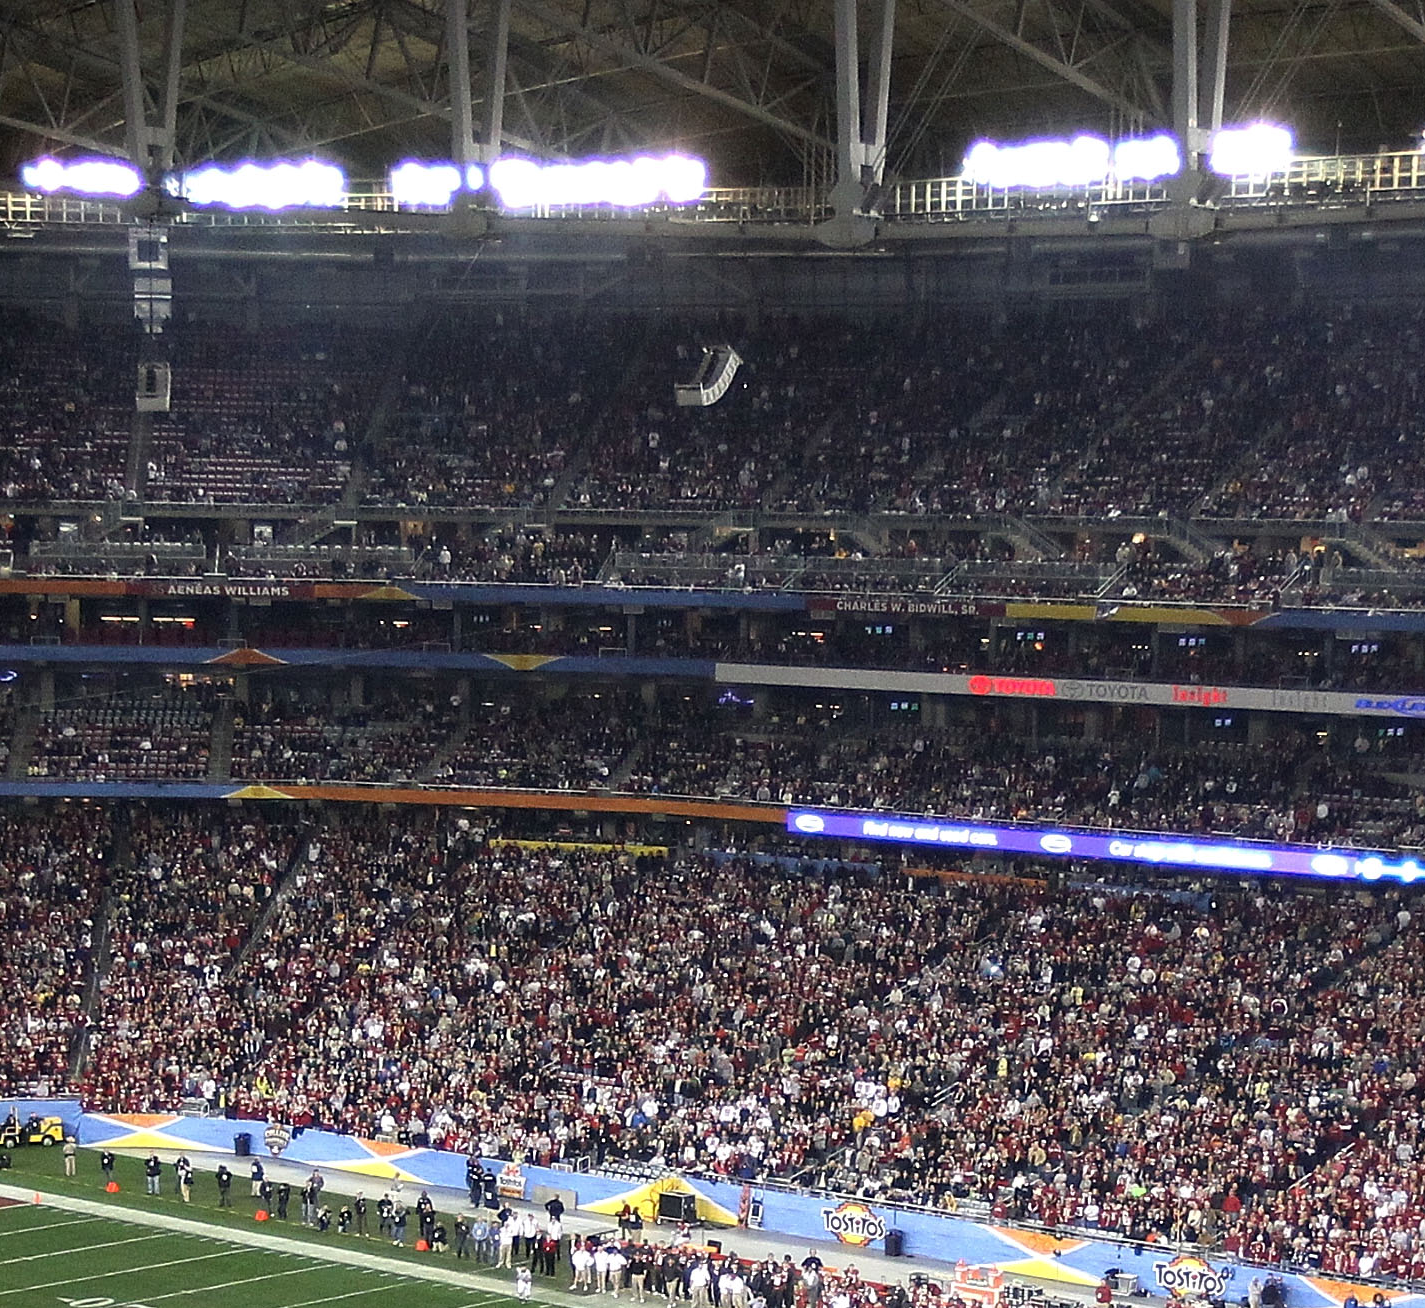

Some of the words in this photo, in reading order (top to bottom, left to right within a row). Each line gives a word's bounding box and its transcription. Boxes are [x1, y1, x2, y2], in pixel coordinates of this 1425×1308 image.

[224, 586, 290, 597] WILLIAMS
[835, 600, 888, 612] CHARLES
[891, 602, 906, 612] W.
[907, 603, 959, 615] BIDWILL,
[960, 604, 980, 615] SR.
[1085, 684, 1149, 700] TOYOTA
[824, 1209, 886, 1240] Tostitos
[1155, 1263, 1226, 1297] Tostitos
